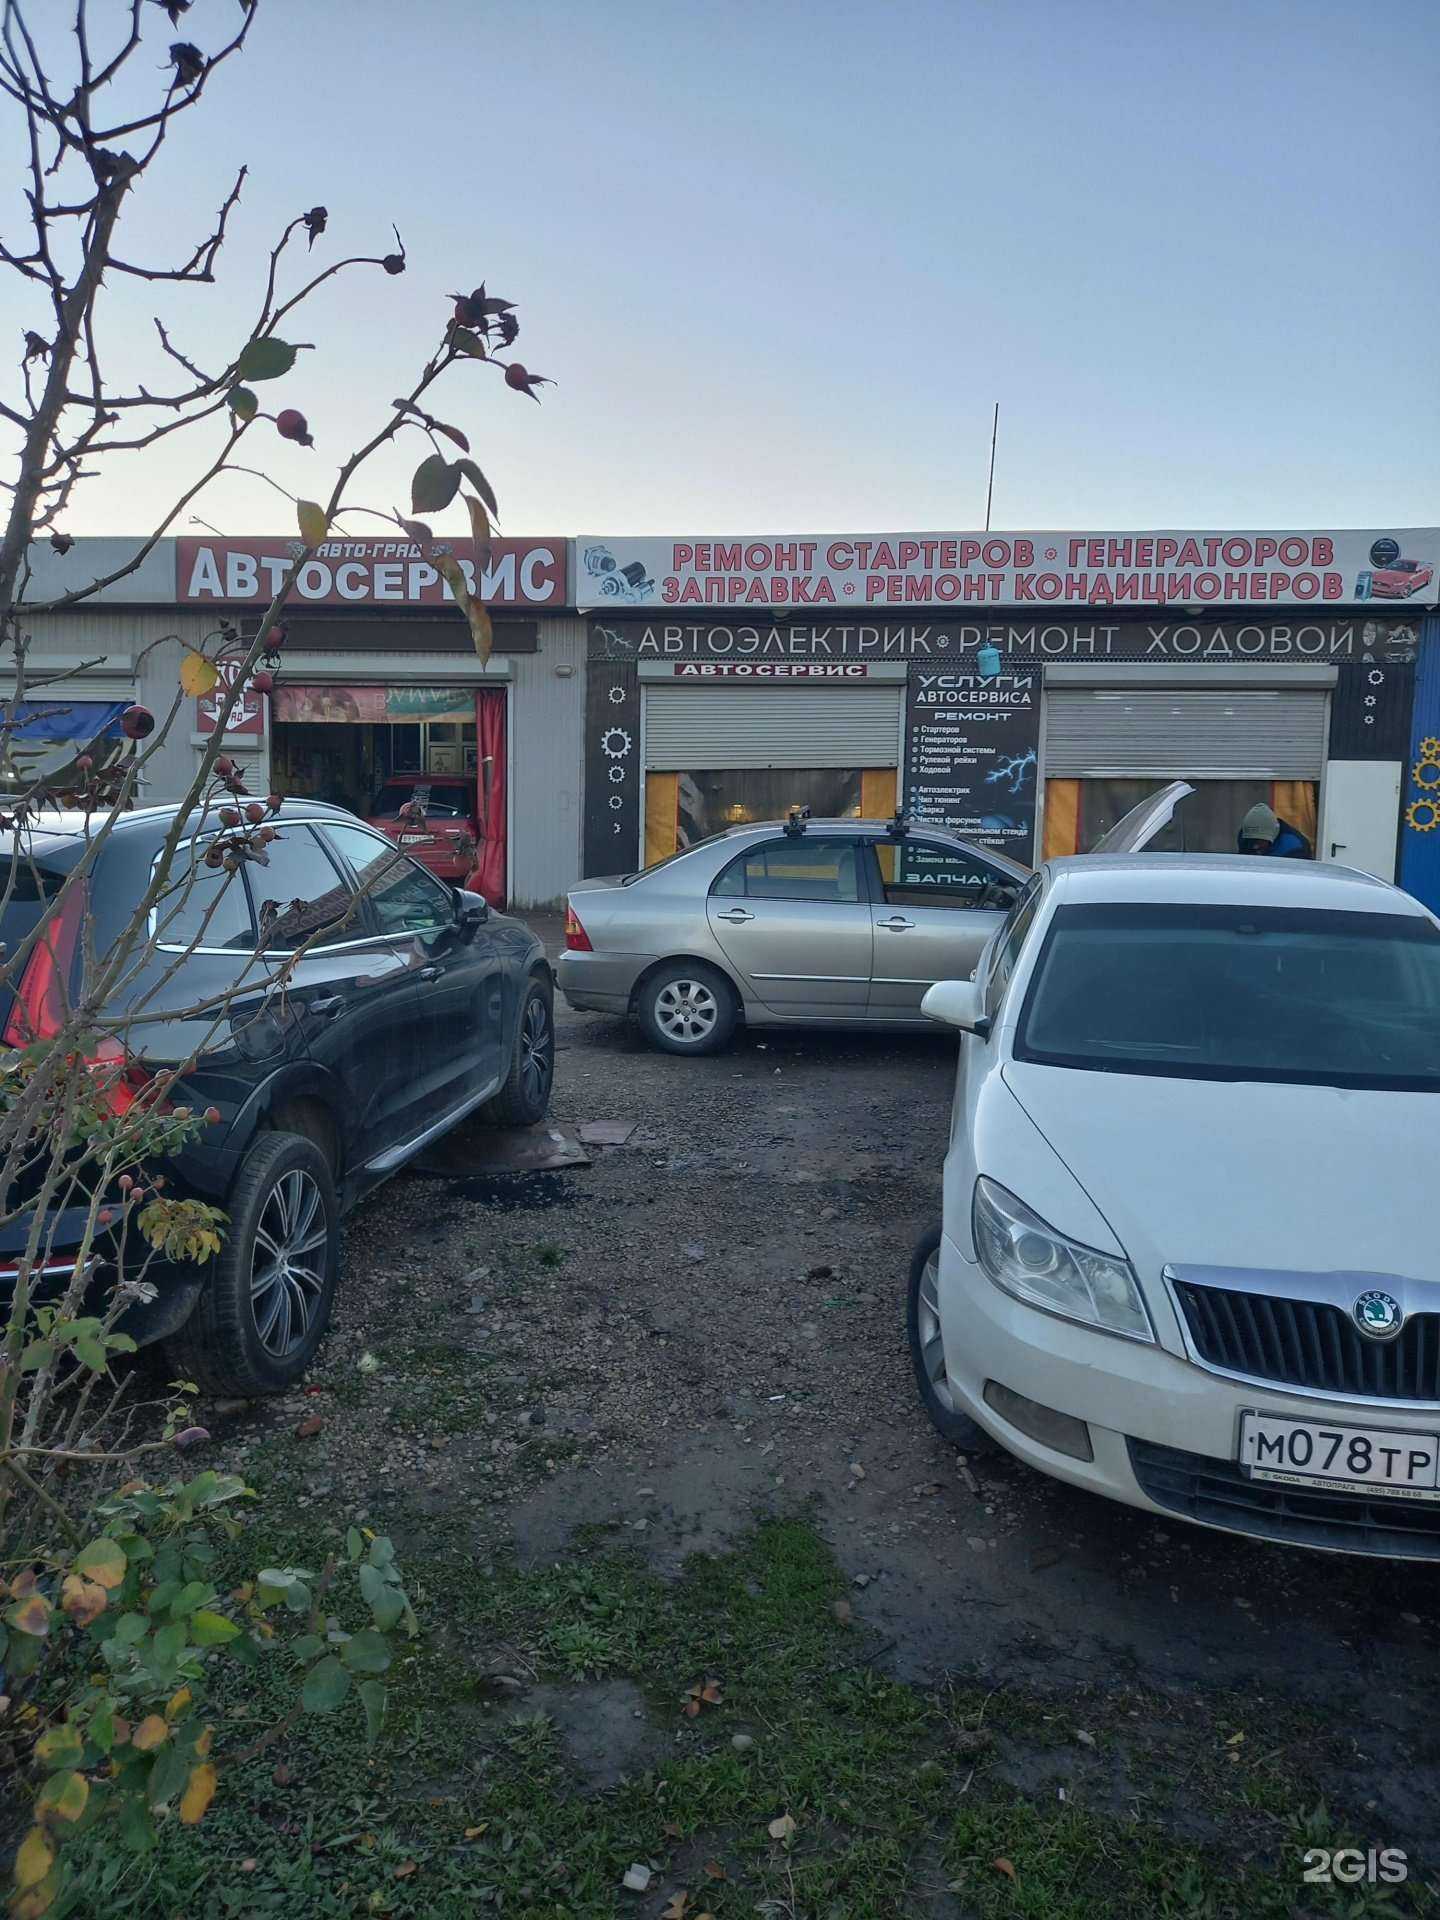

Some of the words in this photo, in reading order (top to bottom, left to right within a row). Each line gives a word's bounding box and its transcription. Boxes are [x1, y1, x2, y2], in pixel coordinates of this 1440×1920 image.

[673, 543, 817, 571] РЕМОНТ
[826, 539, 1035, 571] СТАРТЕРОВ
[1068, 537, 1335, 568] ГЕНЕРАТОРОВ
[661, 576, 836, 603] ЗАПРАВКА
[865, 573, 1006, 602] РЕМОНТ
[1014, 572, 1344, 604] КОНДИЦИОНЕРОВ
[637, 626, 932, 654] АВТОЭЛЕКТРИК
[959, 626, 1120, 654] РЕМОНТ
[1145, 620, 1353, 657] ХОДОВОЙ
[681, 664, 864, 676] АВТОСЕРВИС
[918, 675, 1033, 689] УСЛУГИ
[916, 691, 1031, 704] АВТОСЕРВИСА
[934, 712, 1012, 721] РЕМОНТ
[921, 725, 960, 734] Стартеров
[920, 735, 968, 745] Генераторов
[919, 745, 961, 755] Тормозной
[919, 755, 951, 765] Рулевой
[954, 757, 977, 765] рейки
[919, 765, 951, 775] Ходовой
[918, 786, 971, 795] Автоэлектрик
[918, 795, 932, 804] Чип
[917, 805, 945, 814] Сварка
[905, 873, 989, 885] ЗАПЧА
